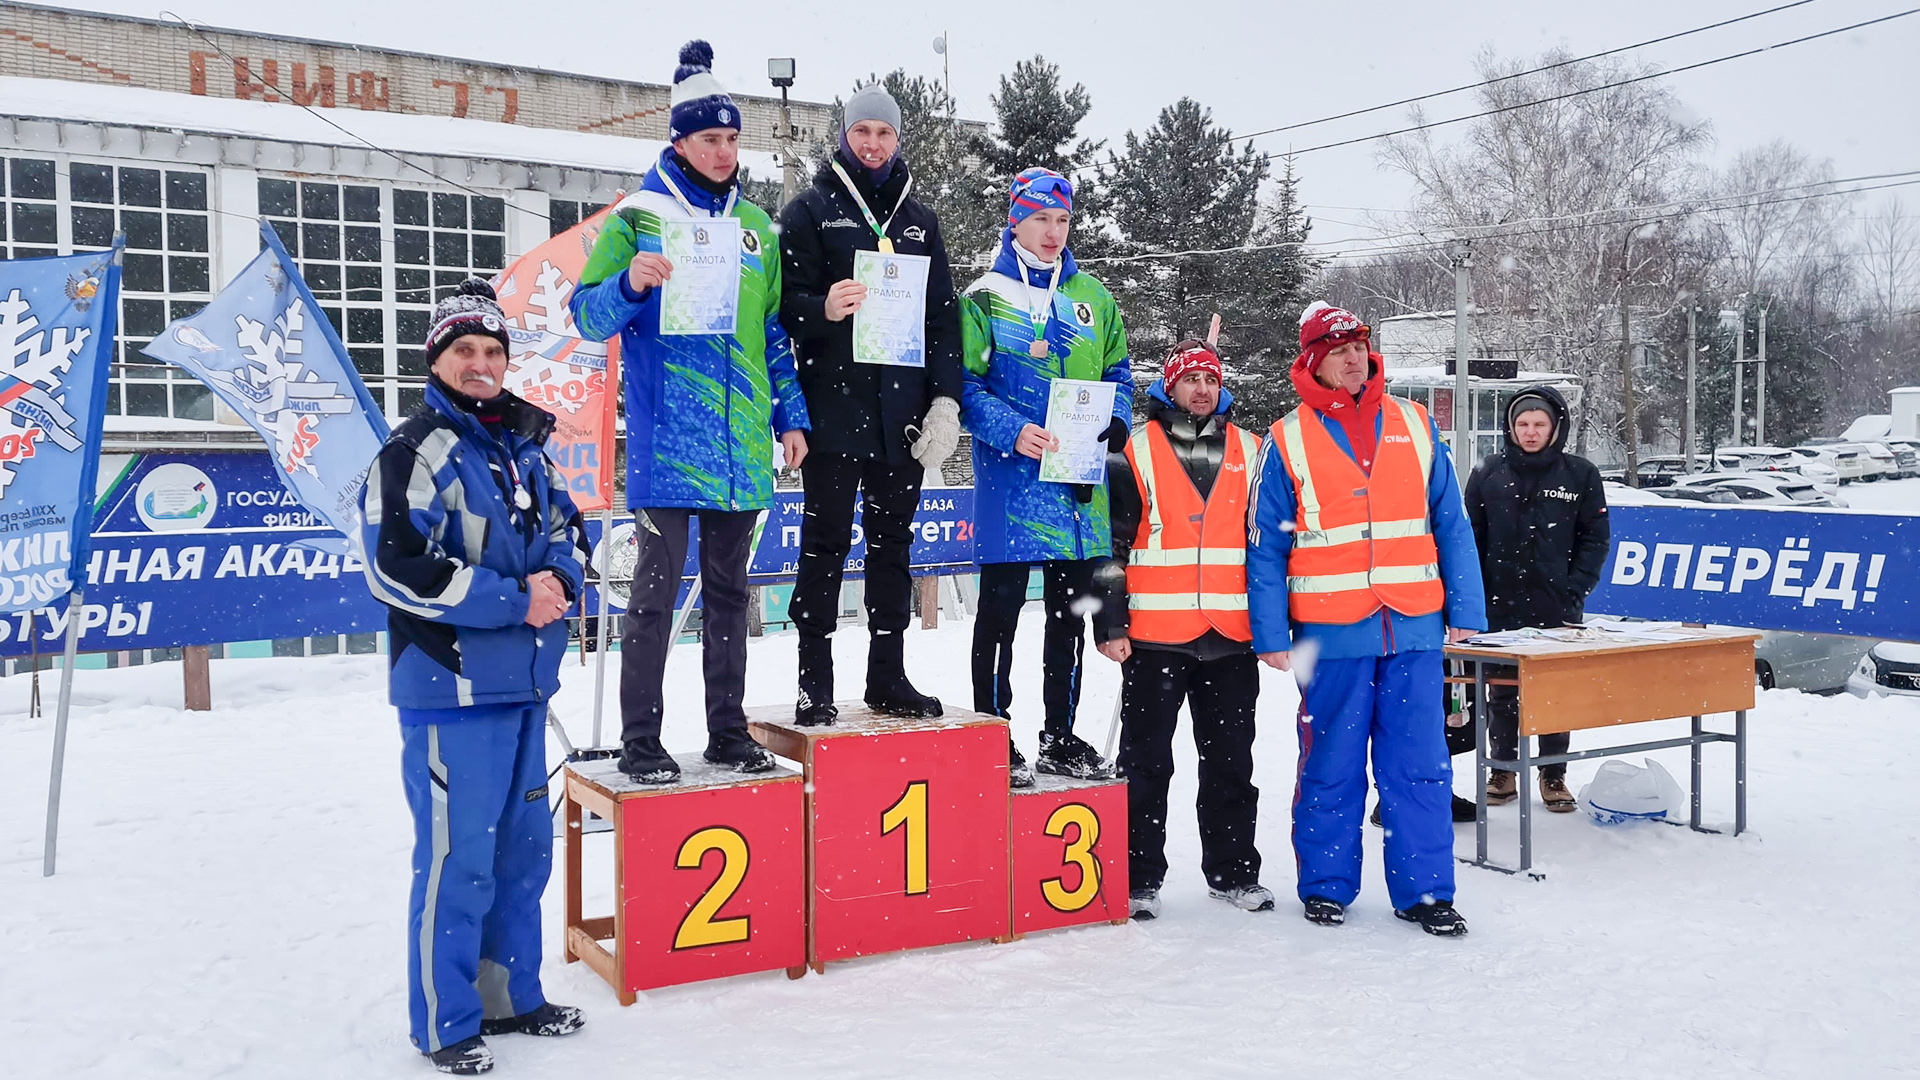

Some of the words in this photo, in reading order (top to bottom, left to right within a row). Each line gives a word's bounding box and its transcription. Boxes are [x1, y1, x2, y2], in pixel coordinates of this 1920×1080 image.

[680, 255, 726, 265] ГРАМОТА
[869, 287, 911, 299] ГРАМОТА
[1061, 412, 1100, 422] ГРАМОТА
[1543, 489, 1579, 501] TOMMY
[923, 499, 954, 511] БАЗА
[1611, 537, 1886, 610] ВПЕРЁД!
[879, 779, 929, 896] 1
[1039, 802, 1103, 912] 3
[671, 824, 751, 951] 2
